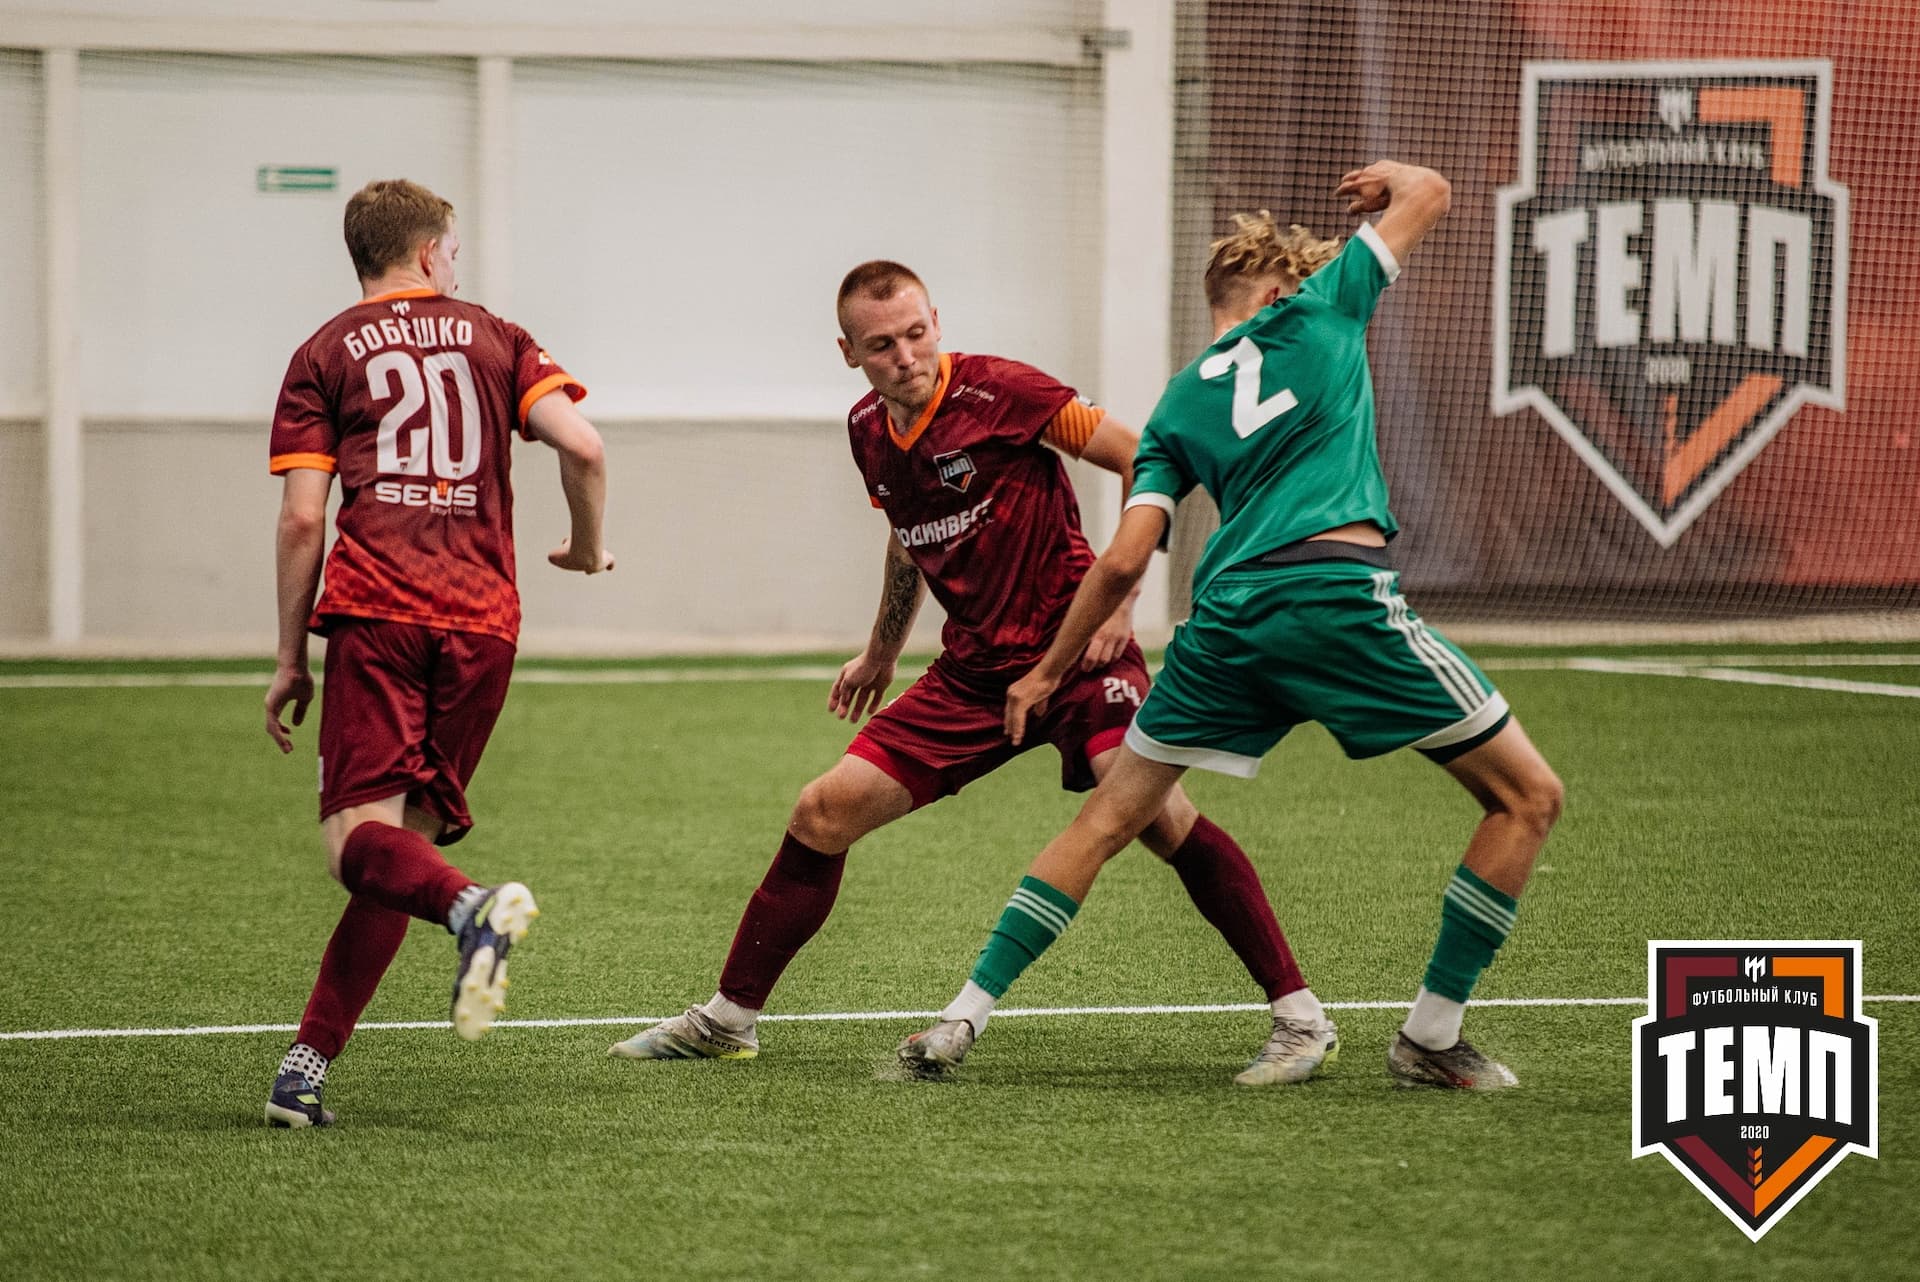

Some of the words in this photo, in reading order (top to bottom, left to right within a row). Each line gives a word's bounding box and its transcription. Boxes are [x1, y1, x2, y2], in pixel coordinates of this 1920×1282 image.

[1533, 197, 1812, 360] ТЕМП
[343, 316, 473, 361] БОБЕШКО
[1199, 335, 1299, 440] 2
[365, 350, 482, 480] 20
[1103, 676, 1141, 707] 24
